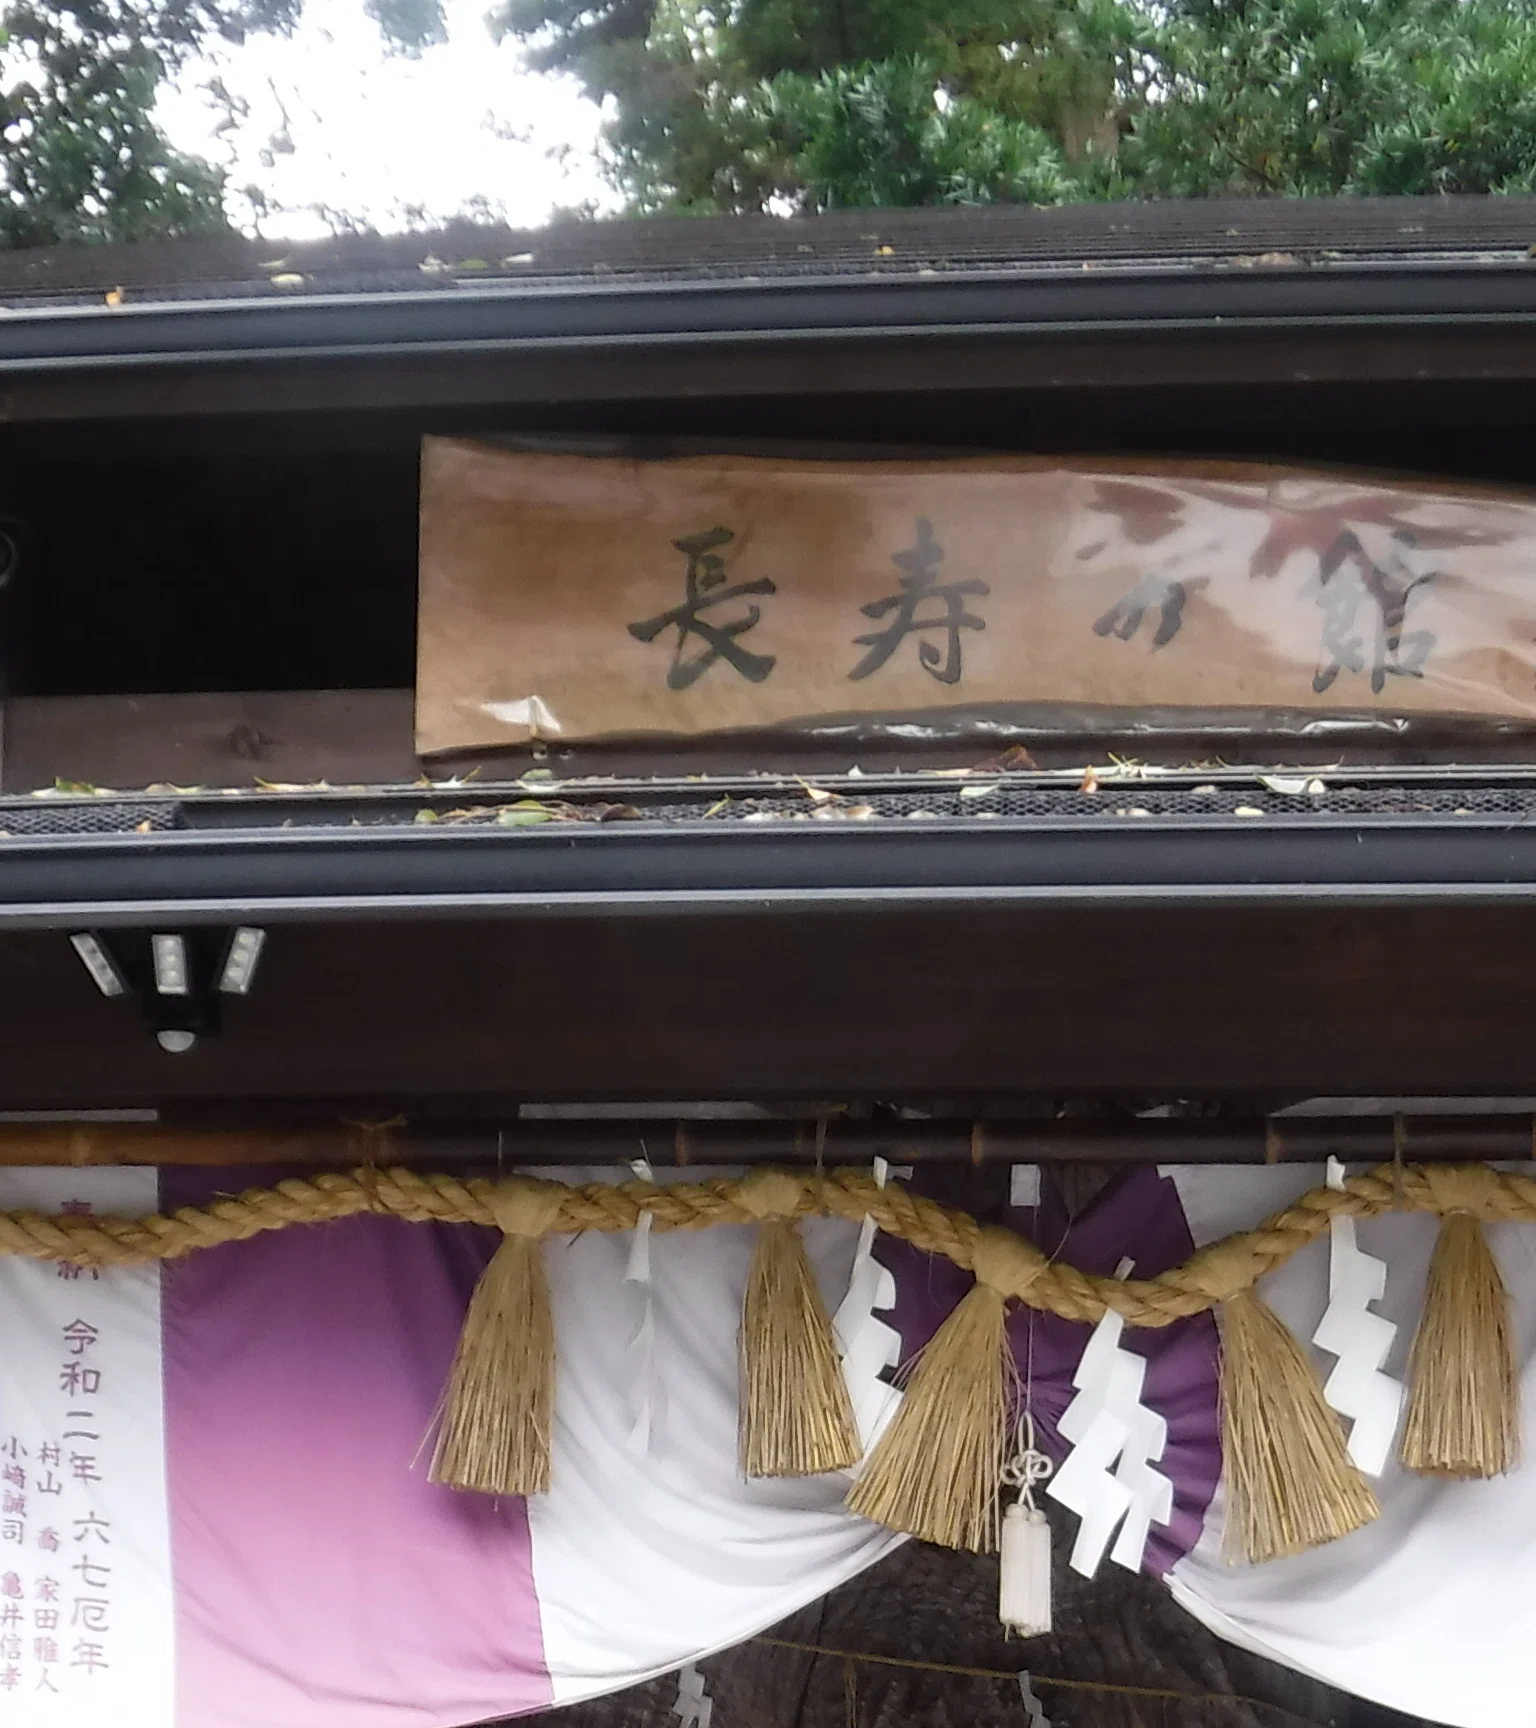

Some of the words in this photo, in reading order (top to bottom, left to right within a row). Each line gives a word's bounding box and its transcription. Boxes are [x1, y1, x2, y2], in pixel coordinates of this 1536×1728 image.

[59, 1317, 102, 1484] 令和二年
[70, 1510, 112, 1676] 六七厄年
